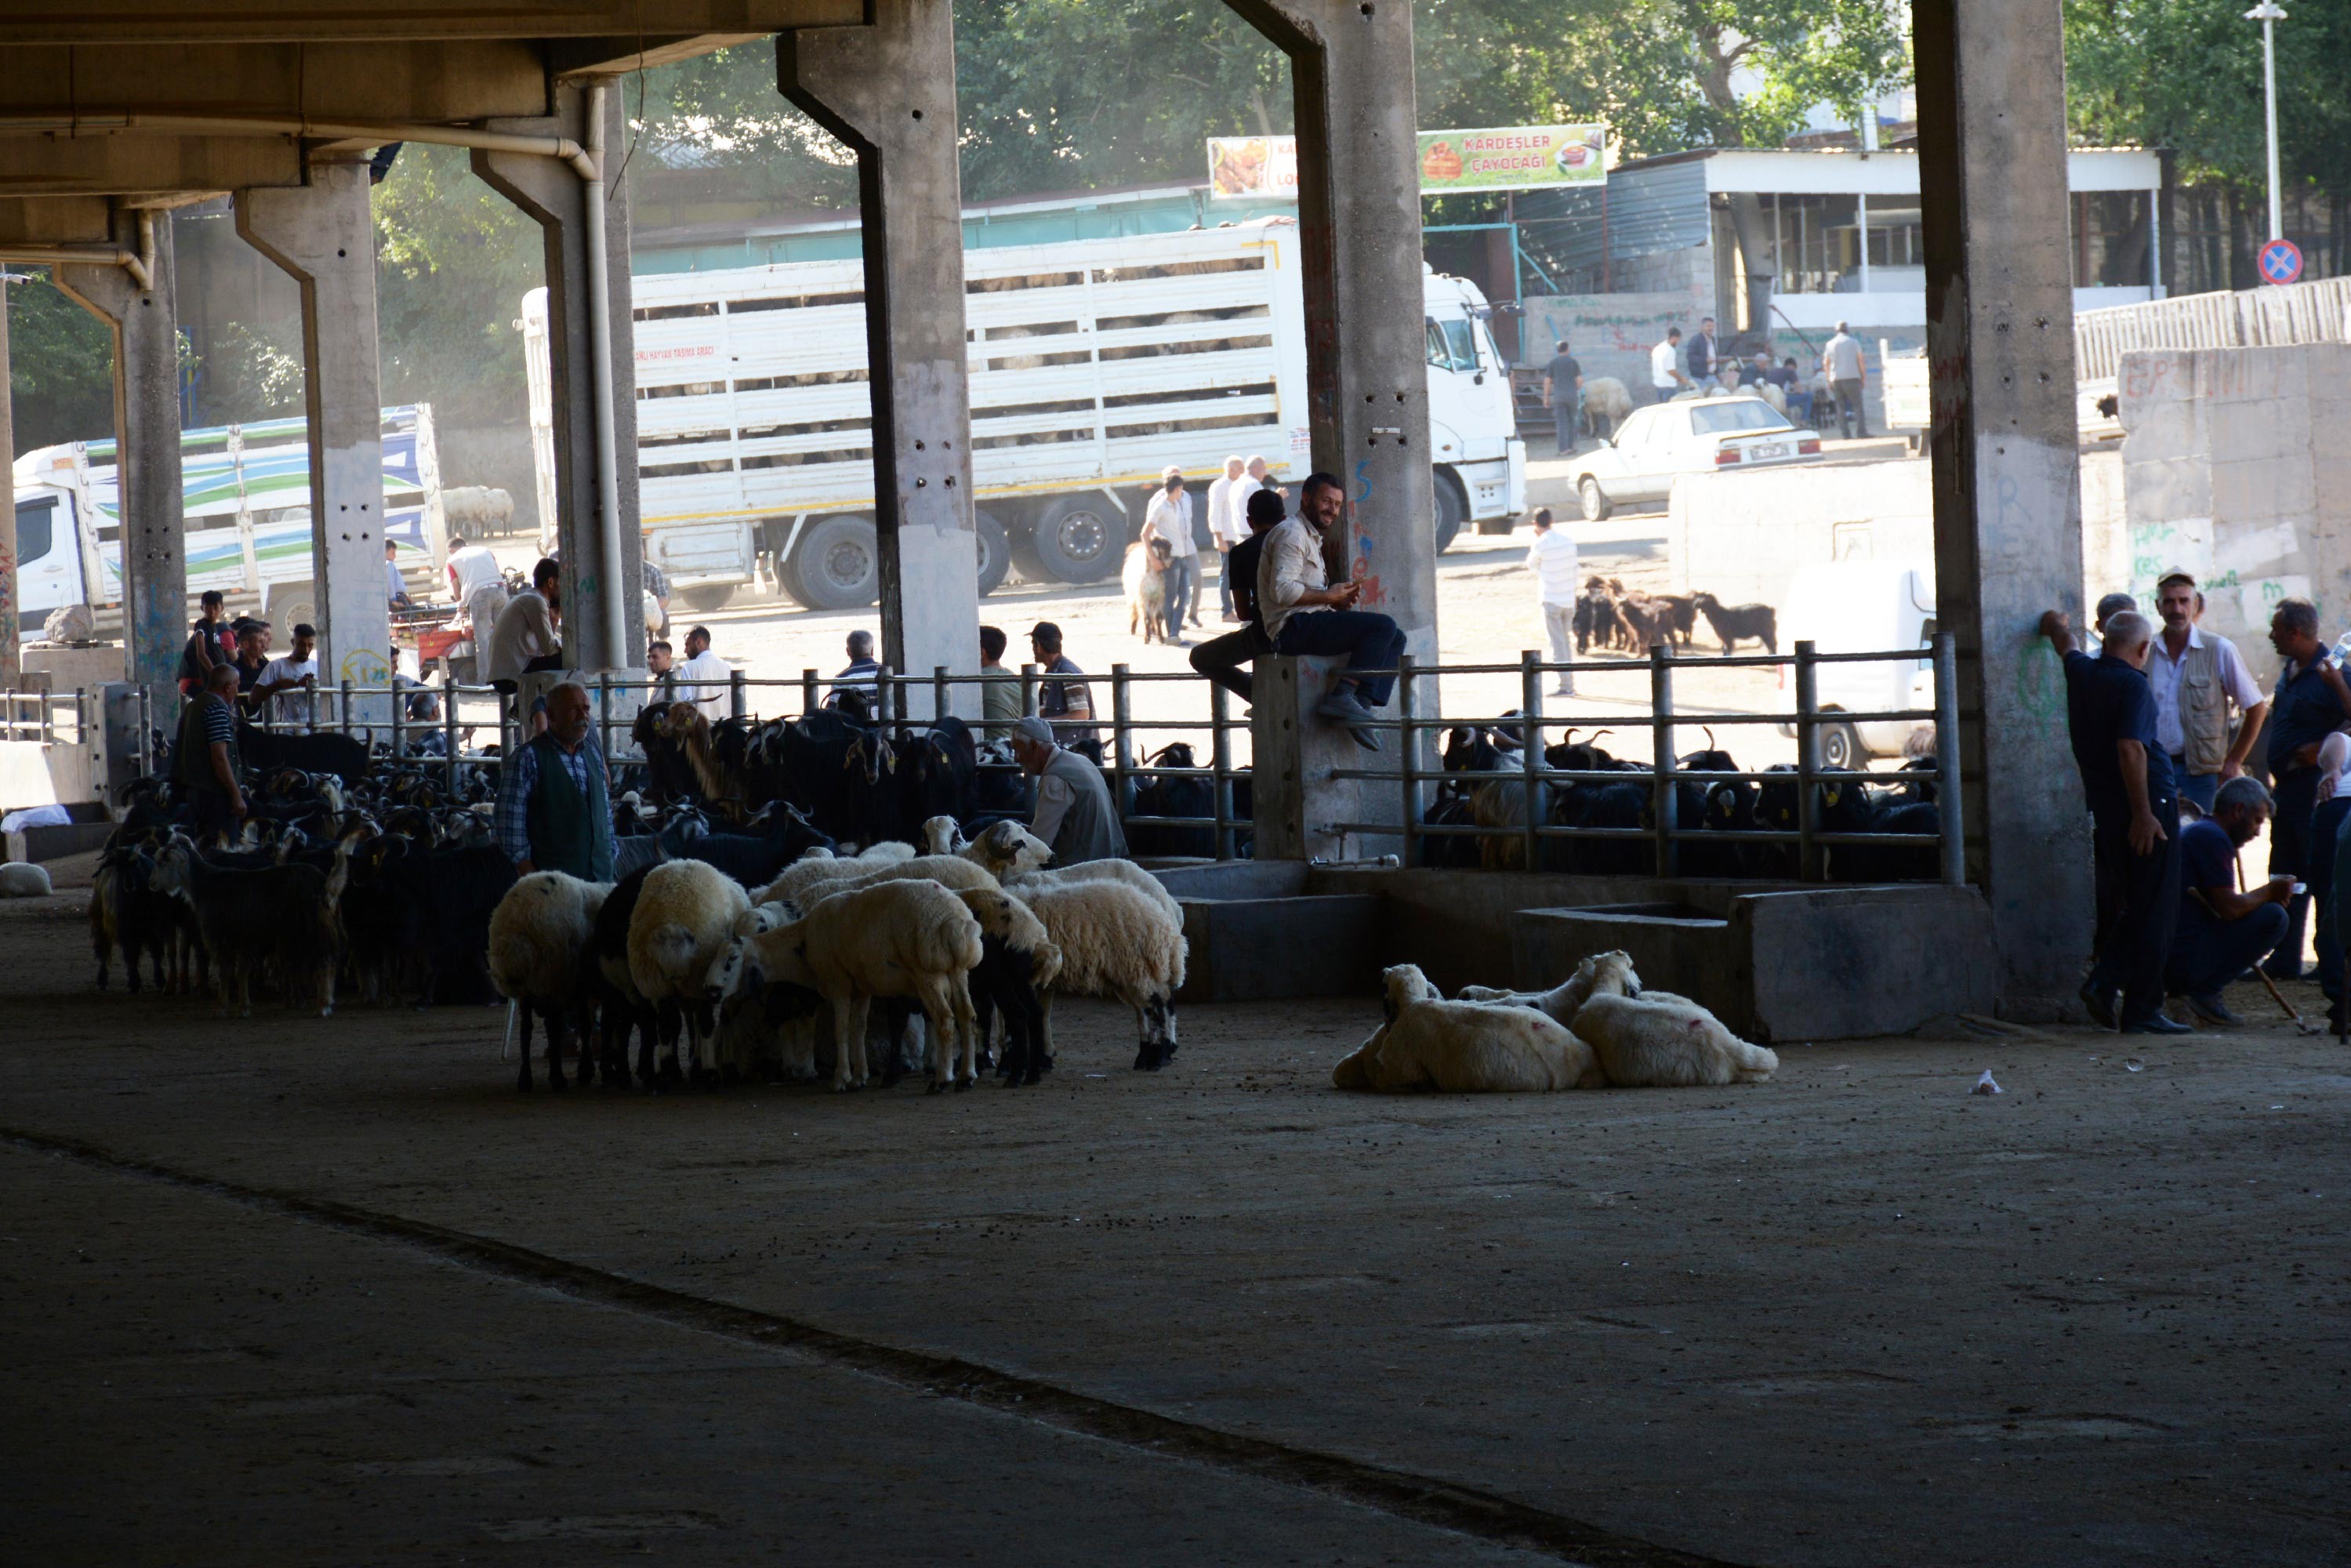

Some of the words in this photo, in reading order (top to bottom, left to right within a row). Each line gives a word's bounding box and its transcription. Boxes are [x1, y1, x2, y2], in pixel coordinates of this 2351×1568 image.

[1278, 143, 1297, 154] KA
[1464, 136, 1551, 151] KARDEŞLER
[1472, 154, 1547, 174] ÇAYOCAĞI
[1277, 173, 1299, 186] LO
